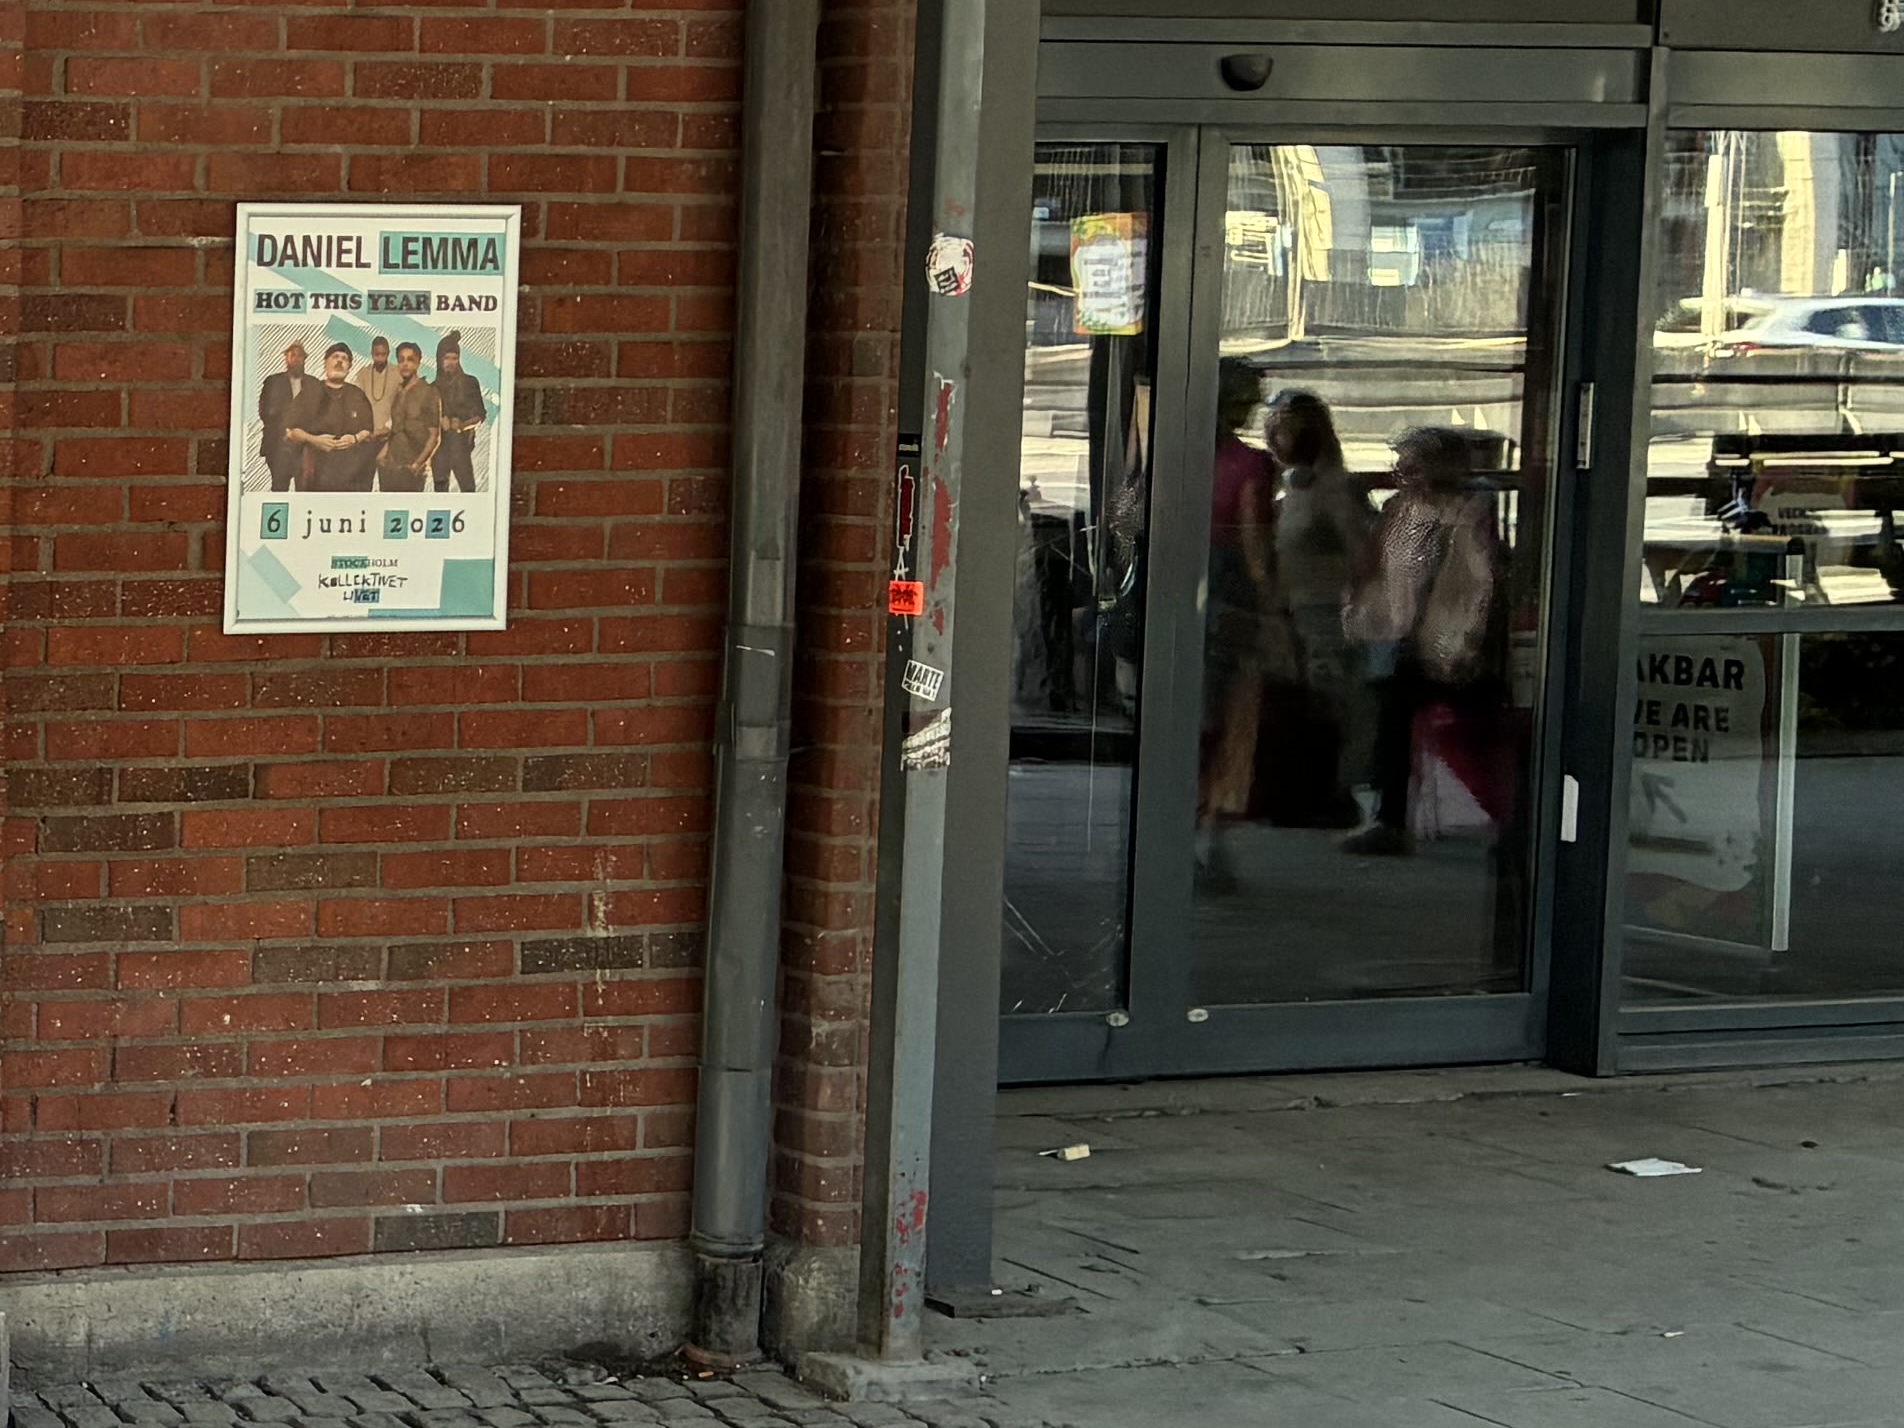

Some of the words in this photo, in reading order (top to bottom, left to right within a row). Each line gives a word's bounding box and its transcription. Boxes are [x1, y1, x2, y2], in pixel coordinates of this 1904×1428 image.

[256, 234, 371, 269] DANIEL
[383, 235, 501, 271] LEMMA
[255, 292, 304, 310] HOT
[310, 292, 362, 310] THIS
[368, 293, 430, 312] YEAR
[436, 294, 497, 312] BAND
[267, 508, 282, 533] 6
[302, 510, 367, 539] juni
[390, 510, 465, 534] 2026
[318, 572, 408, 589] KOLLEKTIVET
[343, 590, 378, 603] LIVET
[1671, 702, 1730, 733] ARE
